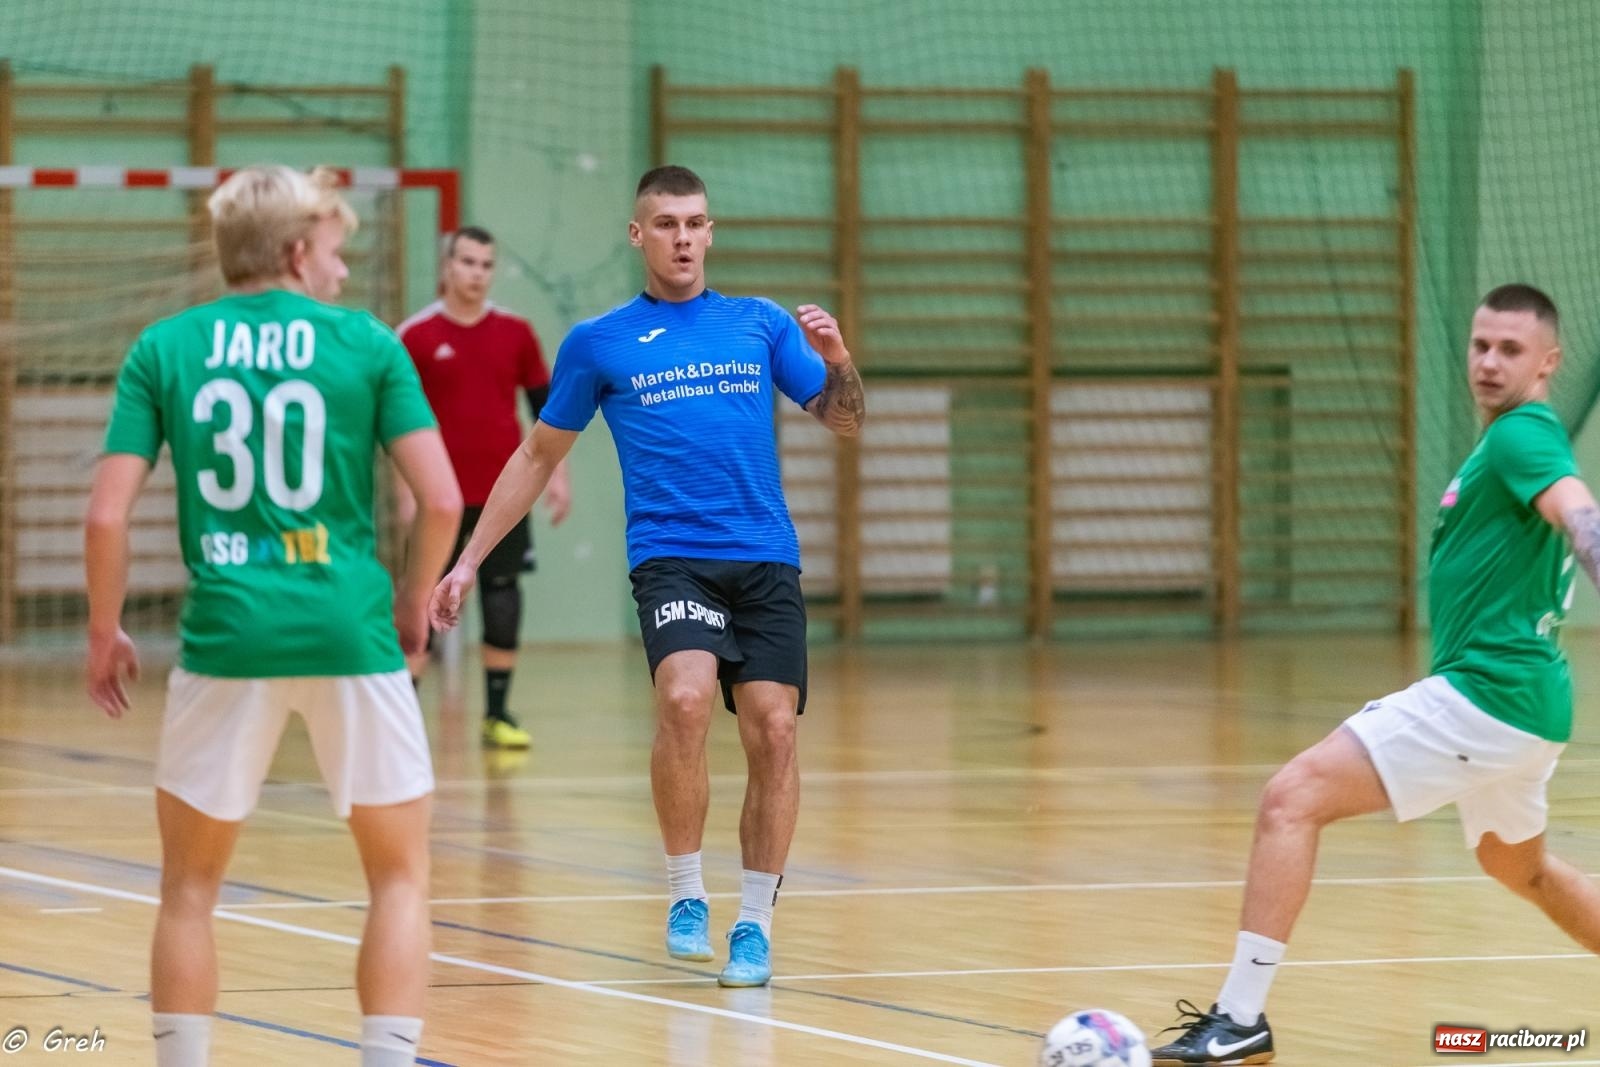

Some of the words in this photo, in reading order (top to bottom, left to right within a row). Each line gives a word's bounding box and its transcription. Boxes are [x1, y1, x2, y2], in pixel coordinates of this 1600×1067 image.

[205, 319, 316, 371] JARO
[630, 360, 761, 391] Marek&Dariusz
[640, 383, 714, 407] Metallbau
[718, 379, 760, 394] GmbH
[192, 378, 327, 512] 30
[654, 600, 687, 629] LSM
[687, 600, 726, 630] SPORT
